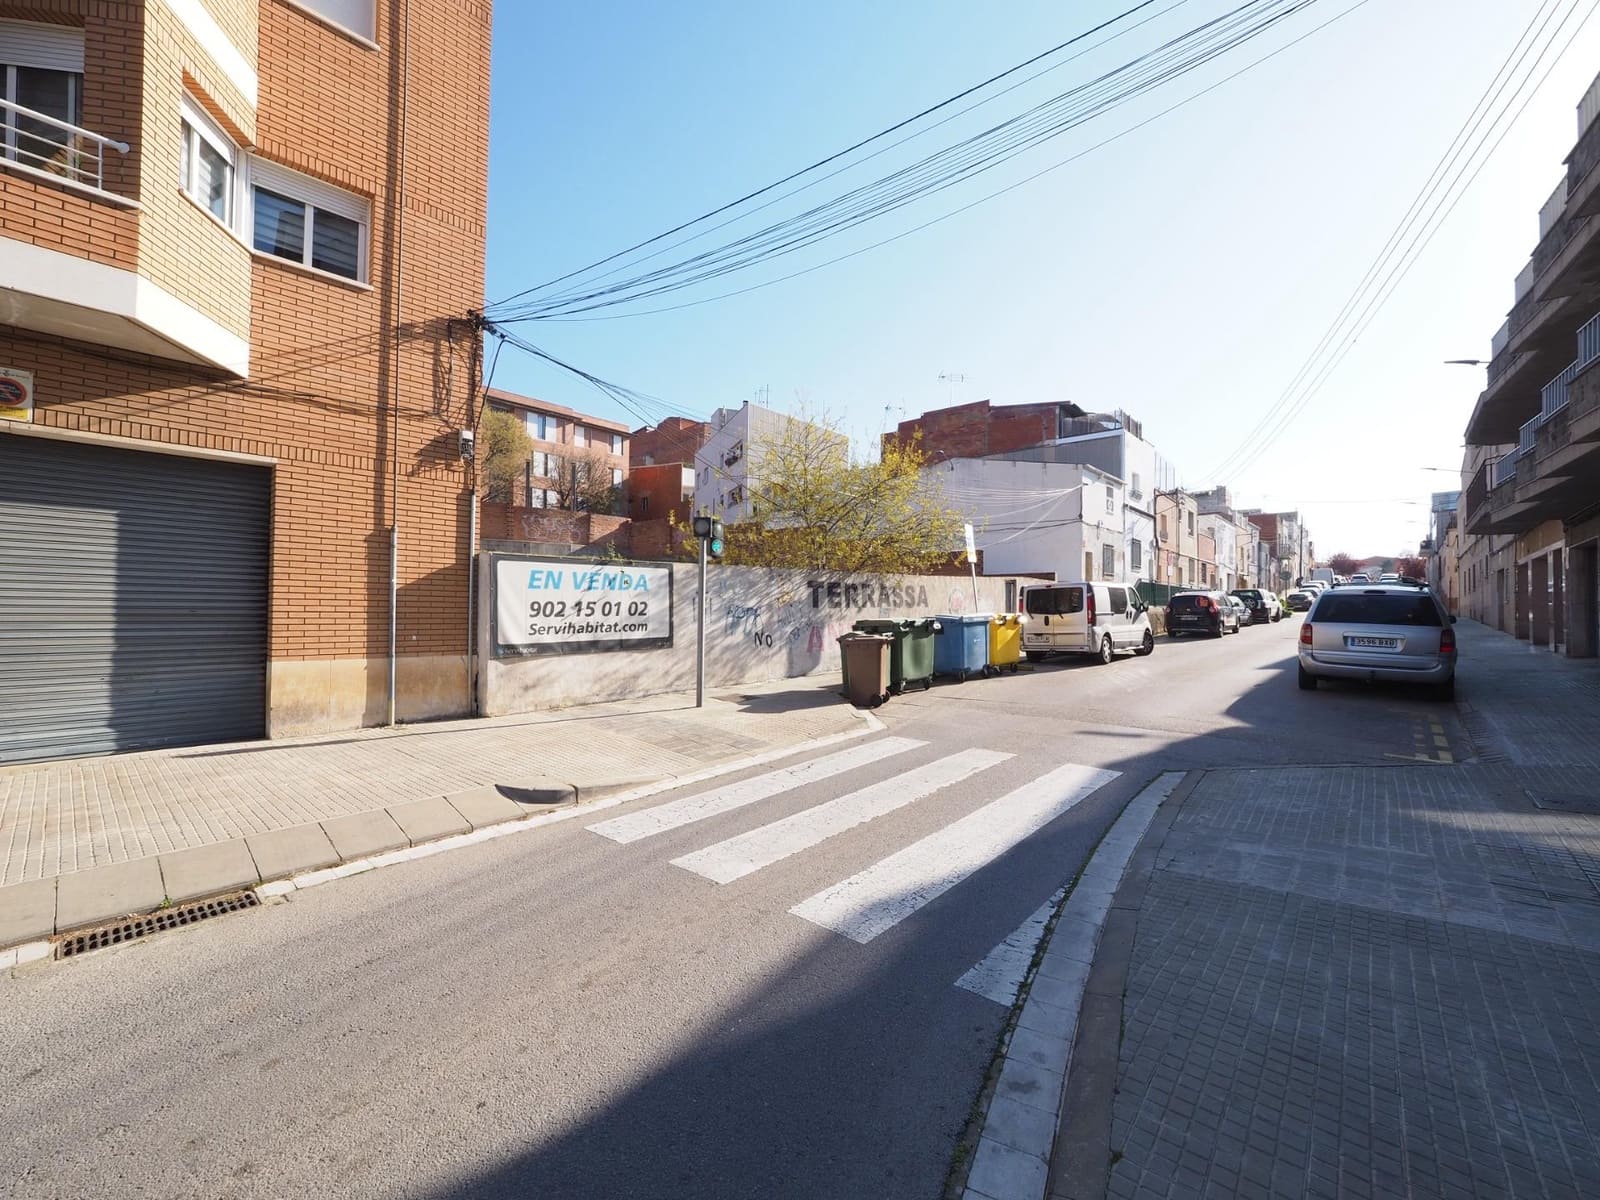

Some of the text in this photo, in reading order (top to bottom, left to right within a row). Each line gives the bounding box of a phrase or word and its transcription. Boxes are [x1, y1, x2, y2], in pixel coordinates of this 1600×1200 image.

[528, 569, 649, 592] EN VENDA
[807, 580, 929, 608] TERRASSA
[529, 601, 648, 618] 902 15 01 02
[528, 622, 648, 636] Servihabitat.com
